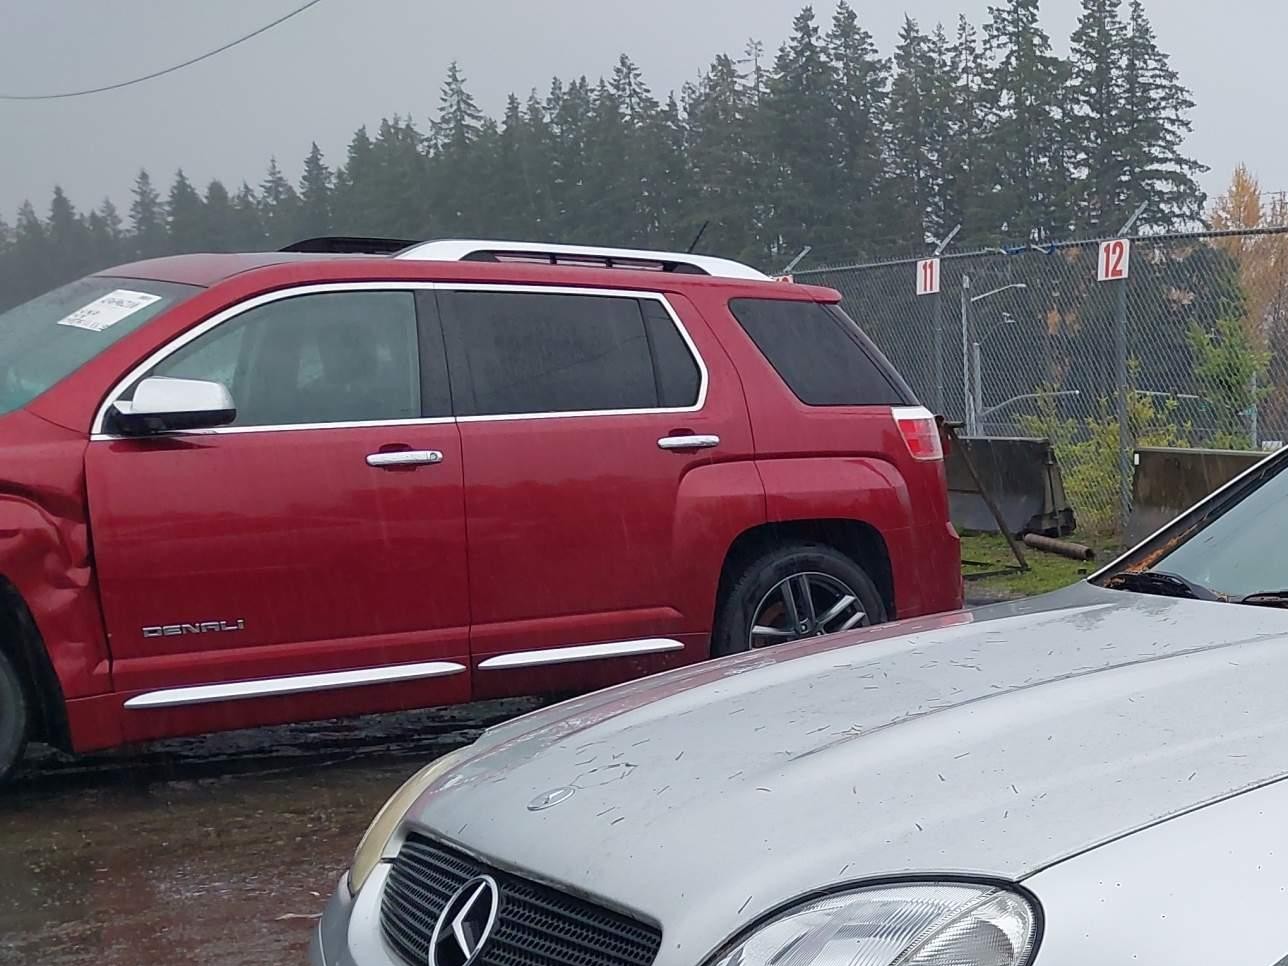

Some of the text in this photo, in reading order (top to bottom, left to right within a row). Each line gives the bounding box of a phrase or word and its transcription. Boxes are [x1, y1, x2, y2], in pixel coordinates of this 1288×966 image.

[1103, 241, 1123, 278] 12
[922, 261, 934, 292] 11
[142, 619, 244, 638] DENALI
